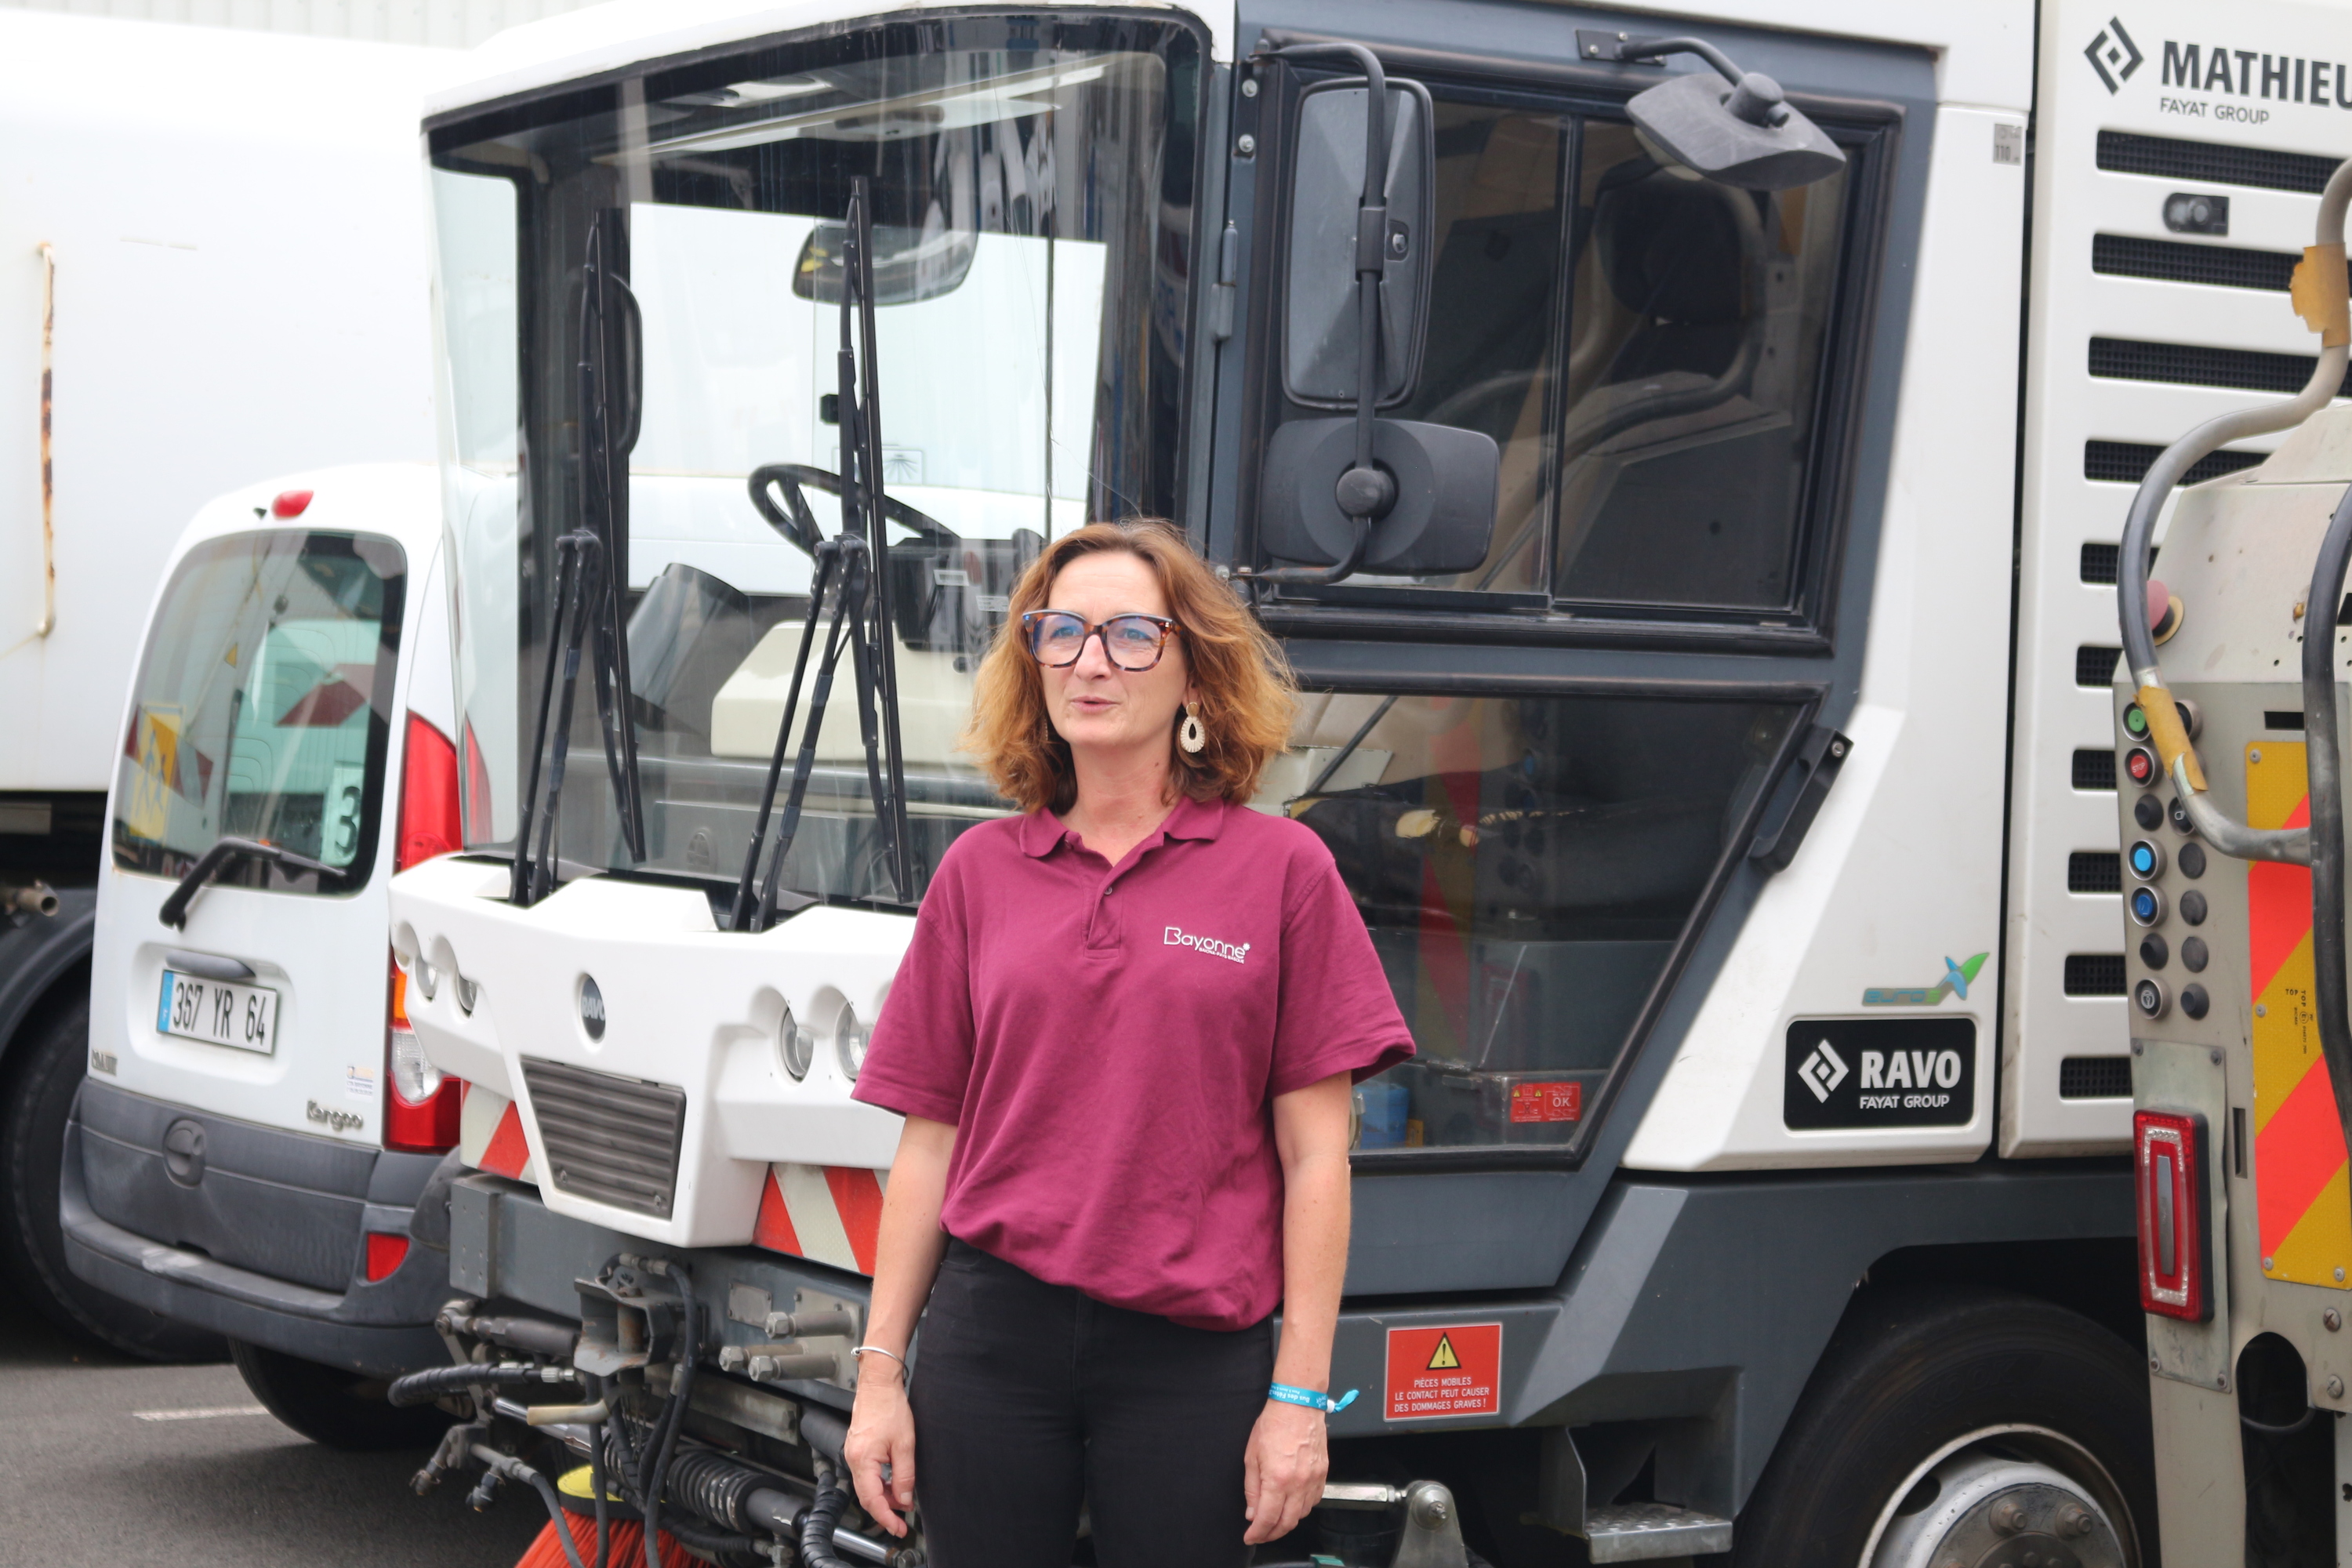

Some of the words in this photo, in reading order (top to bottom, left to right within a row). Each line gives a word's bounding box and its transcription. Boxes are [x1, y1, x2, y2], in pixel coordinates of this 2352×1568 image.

[2161, 40, 2352, 109] MATHIEU
[2160, 97, 2208, 118] FAYAT
[2214, 104, 2270, 125] GROUP
[2132, 762, 2146, 773] STOP
[172, 982, 203, 1033] 367
[212, 988, 234, 1040] YR
[245, 994, 267, 1047] 64
[1860, 1051, 1962, 1089] RAVO
[1859, 1095, 1900, 1109] FAYAT
[1904, 1094, 1950, 1109] GROUP
[1414, 1377, 1439, 1388] PIÈCES
[1441, 1377, 1472, 1387] MOBILES
[1395, 1392, 1404, 1401] LE
[1406, 1390, 1438, 1400] CONTACT
[1440, 1389, 1459, 1398] PEUT
[1461, 1387, 1490, 1396] CAUSER
[1394, 1403, 1409, 1413] DES
[1411, 1401, 1451, 1411] DOMMAGES
[1454, 1399, 1481, 1409] GRAVES
